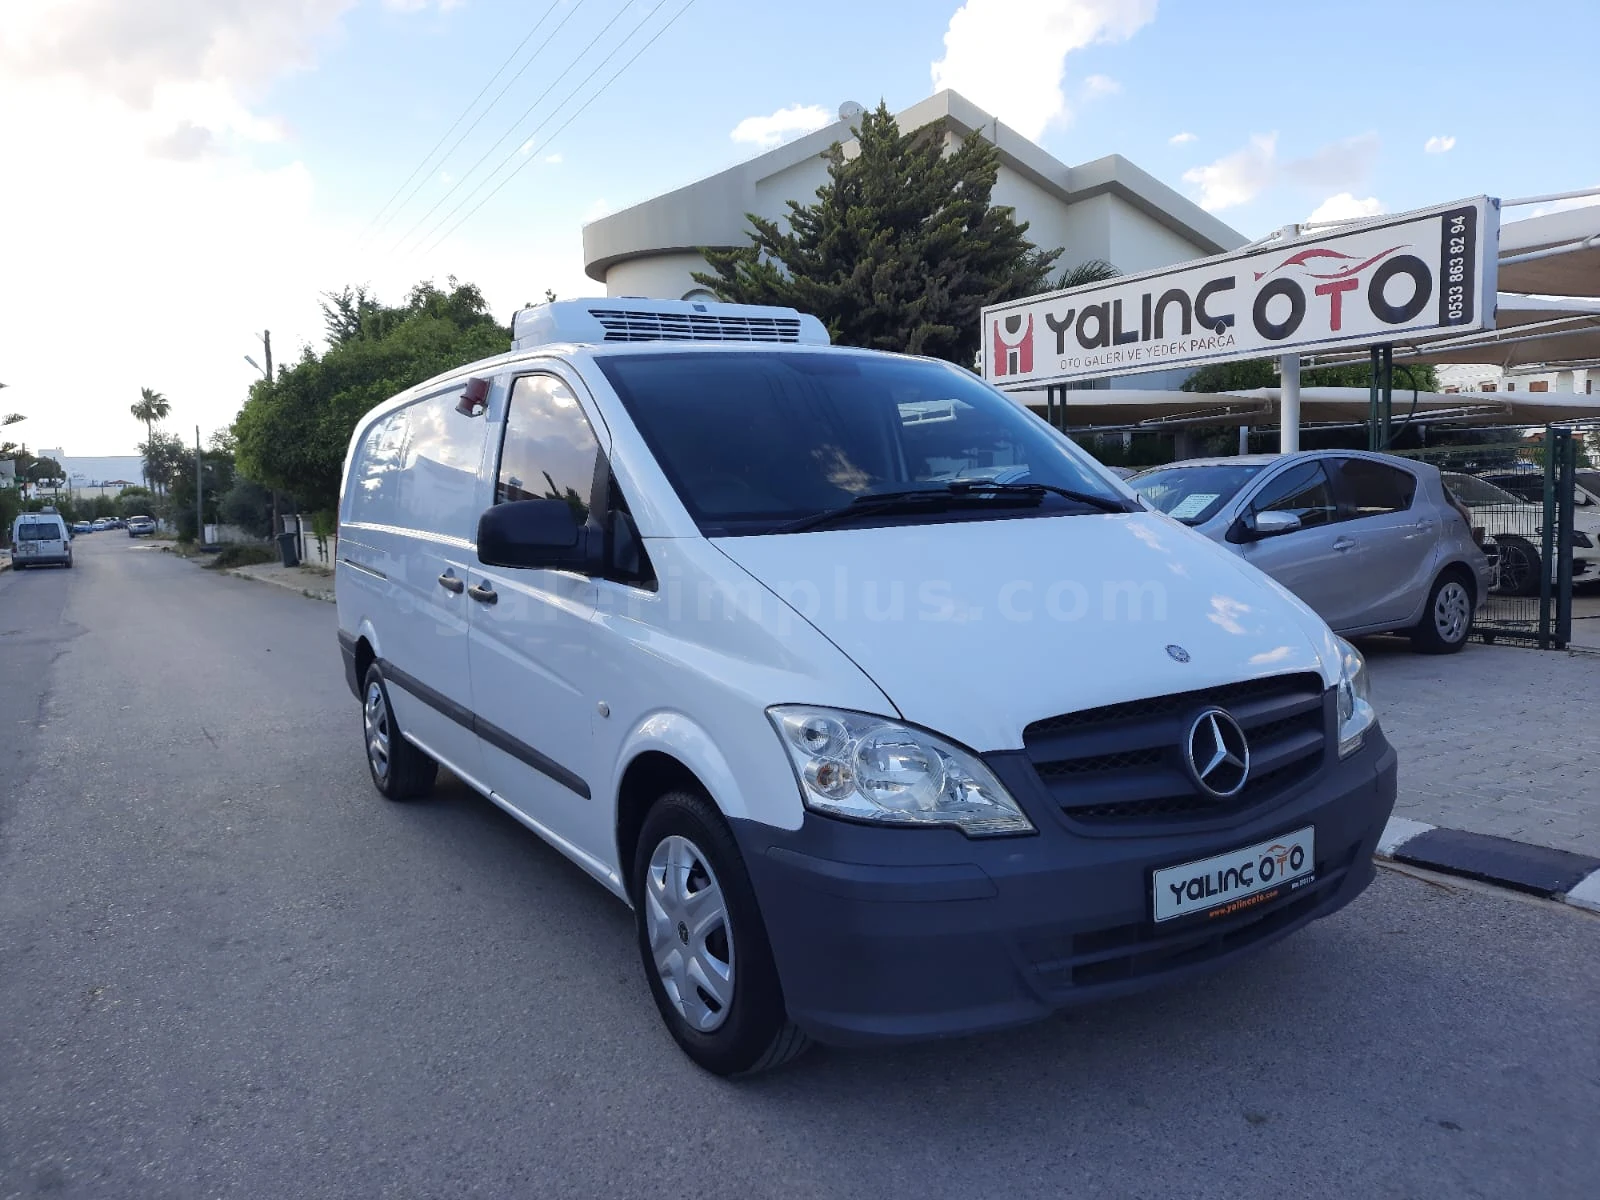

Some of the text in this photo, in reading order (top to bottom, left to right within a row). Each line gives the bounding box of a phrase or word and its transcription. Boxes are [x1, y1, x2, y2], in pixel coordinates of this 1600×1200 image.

[1253, 254, 1433, 341] OTO
[1448, 215, 1466, 319] 0533 863 82 94
[1060, 358, 1081, 370] OTO
[1127, 348, 1142, 361] VE
[1145, 341, 1187, 357] YEDEK
[1190, 335, 1236, 352] PARÇA
[1259, 845, 1305, 882] OTO
